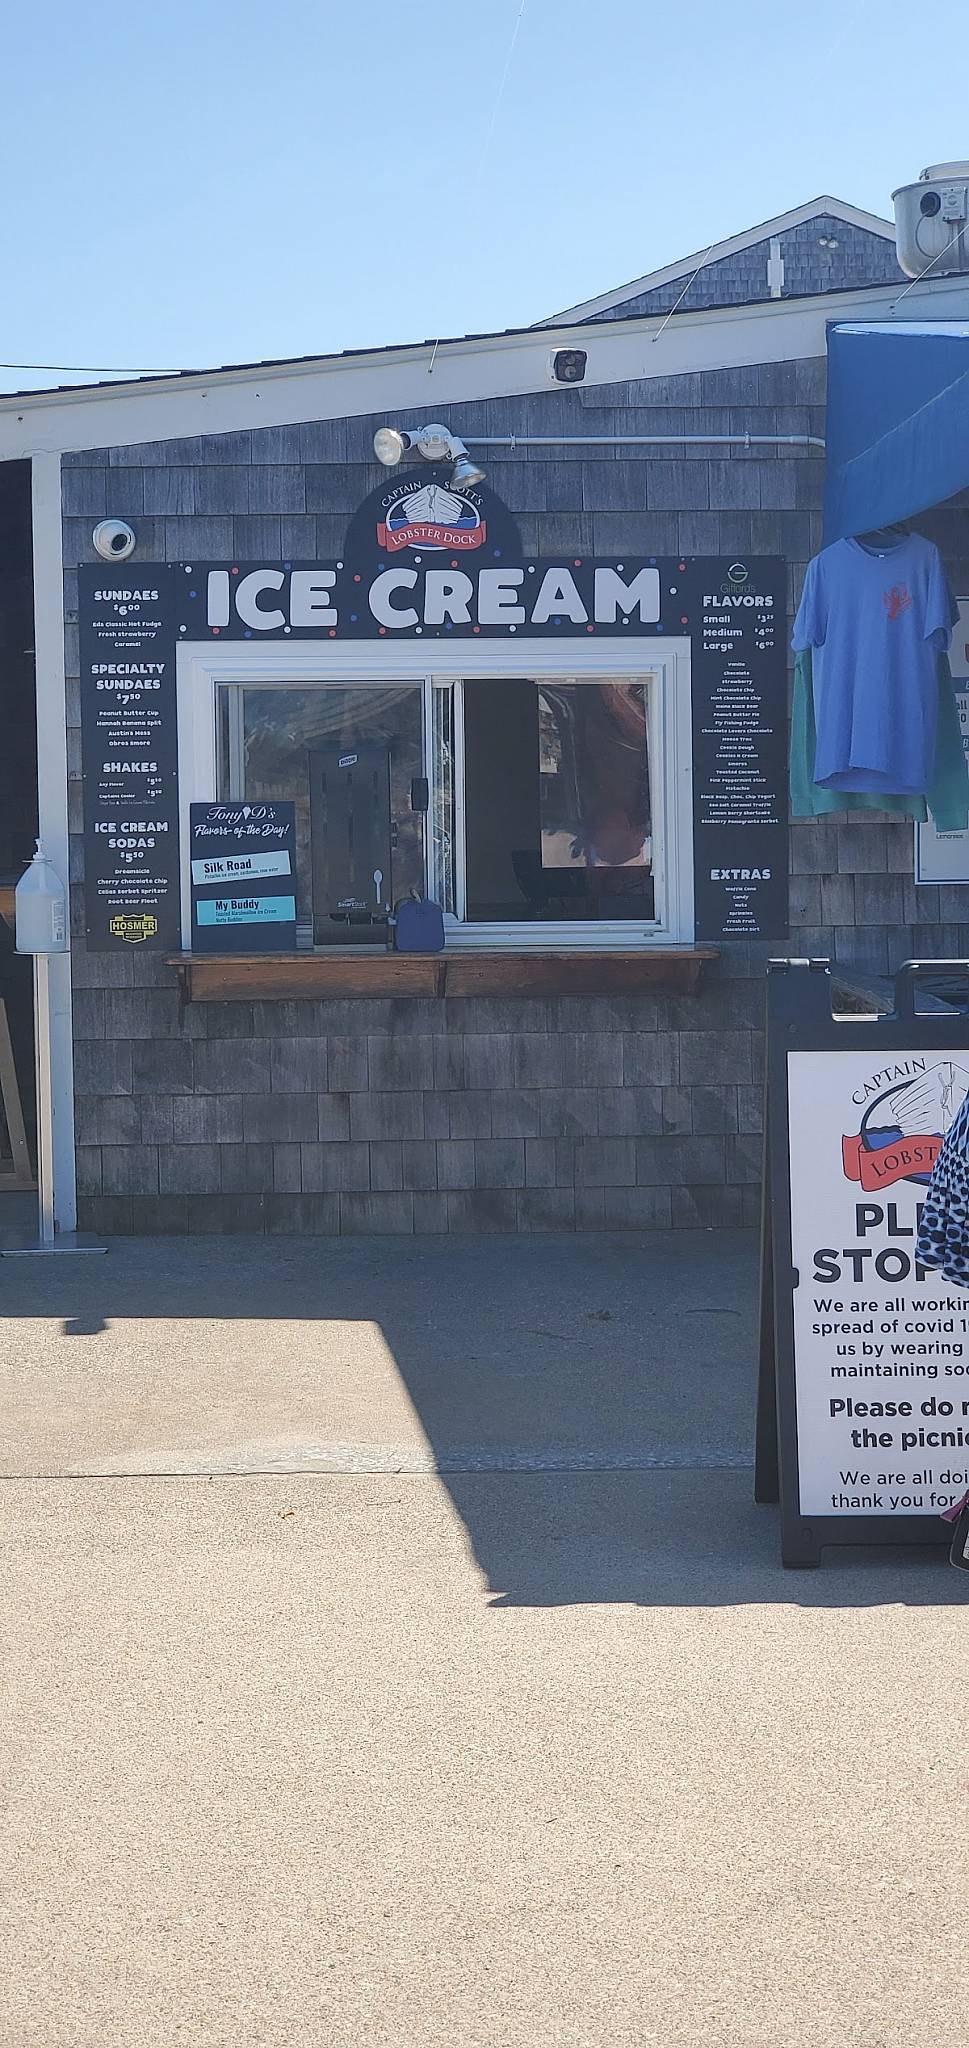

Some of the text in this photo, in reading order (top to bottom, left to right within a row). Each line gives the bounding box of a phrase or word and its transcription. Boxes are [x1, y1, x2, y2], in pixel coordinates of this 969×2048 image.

[381, 481, 484, 507] CAPTAIN STT'S
[391, 528, 441, 545] LOBSTER
[94, 590, 159, 601] SUNDAES
[207, 567, 660, 631] ICE CREAM
[703, 596, 774, 607] FLAVORS
[703, 615, 731, 623] Small
[703, 628, 743, 637] Medium
[703, 642, 734, 652] Large
[91, 663, 165, 674] SPECIALTY
[96, 679, 160, 690] SUNDAES
[103, 762, 158, 773] SHAKES
[207, 807, 243, 824] Tony
[95, 821, 168, 833] ICE CREAM
[234, 826, 246, 838] of
[246, 824, 261, 835] the
[261, 823, 290, 838] Day!
[108, 838, 155, 849] SODAS
[204, 862, 223, 873] Silk
[227, 859, 252, 871] Road
[710, 869, 771, 880] EXTRAS
[216, 899, 259, 911] My Buddy
[113, 921, 154, 930] HOSMER
[852, 1058, 926, 1105] CAPTAIN
[870, 1146, 938, 1177] LOBST
[813, 1299, 844, 1313] We
[850, 1301, 879, 1312] are
[885, 1298, 905, 1312] all
[812, 1320, 873, 1337] spread
[880, 1319, 899, 1334] of
[905, 1319, 954, 1333] covid
[836, 1341, 963, 1358] us by wearing
[831, 1362, 938, 1379] maintaining
[830, 1398, 912, 1417] Please
[921, 1397, 953, 1416] do
[851, 1428, 893, 1448] the
[840, 1471, 871, 1485] We
[877, 1473, 905, 1485] are
[912, 1470, 933, 1484] all
[832, 1492, 956, 1510] thank you for
